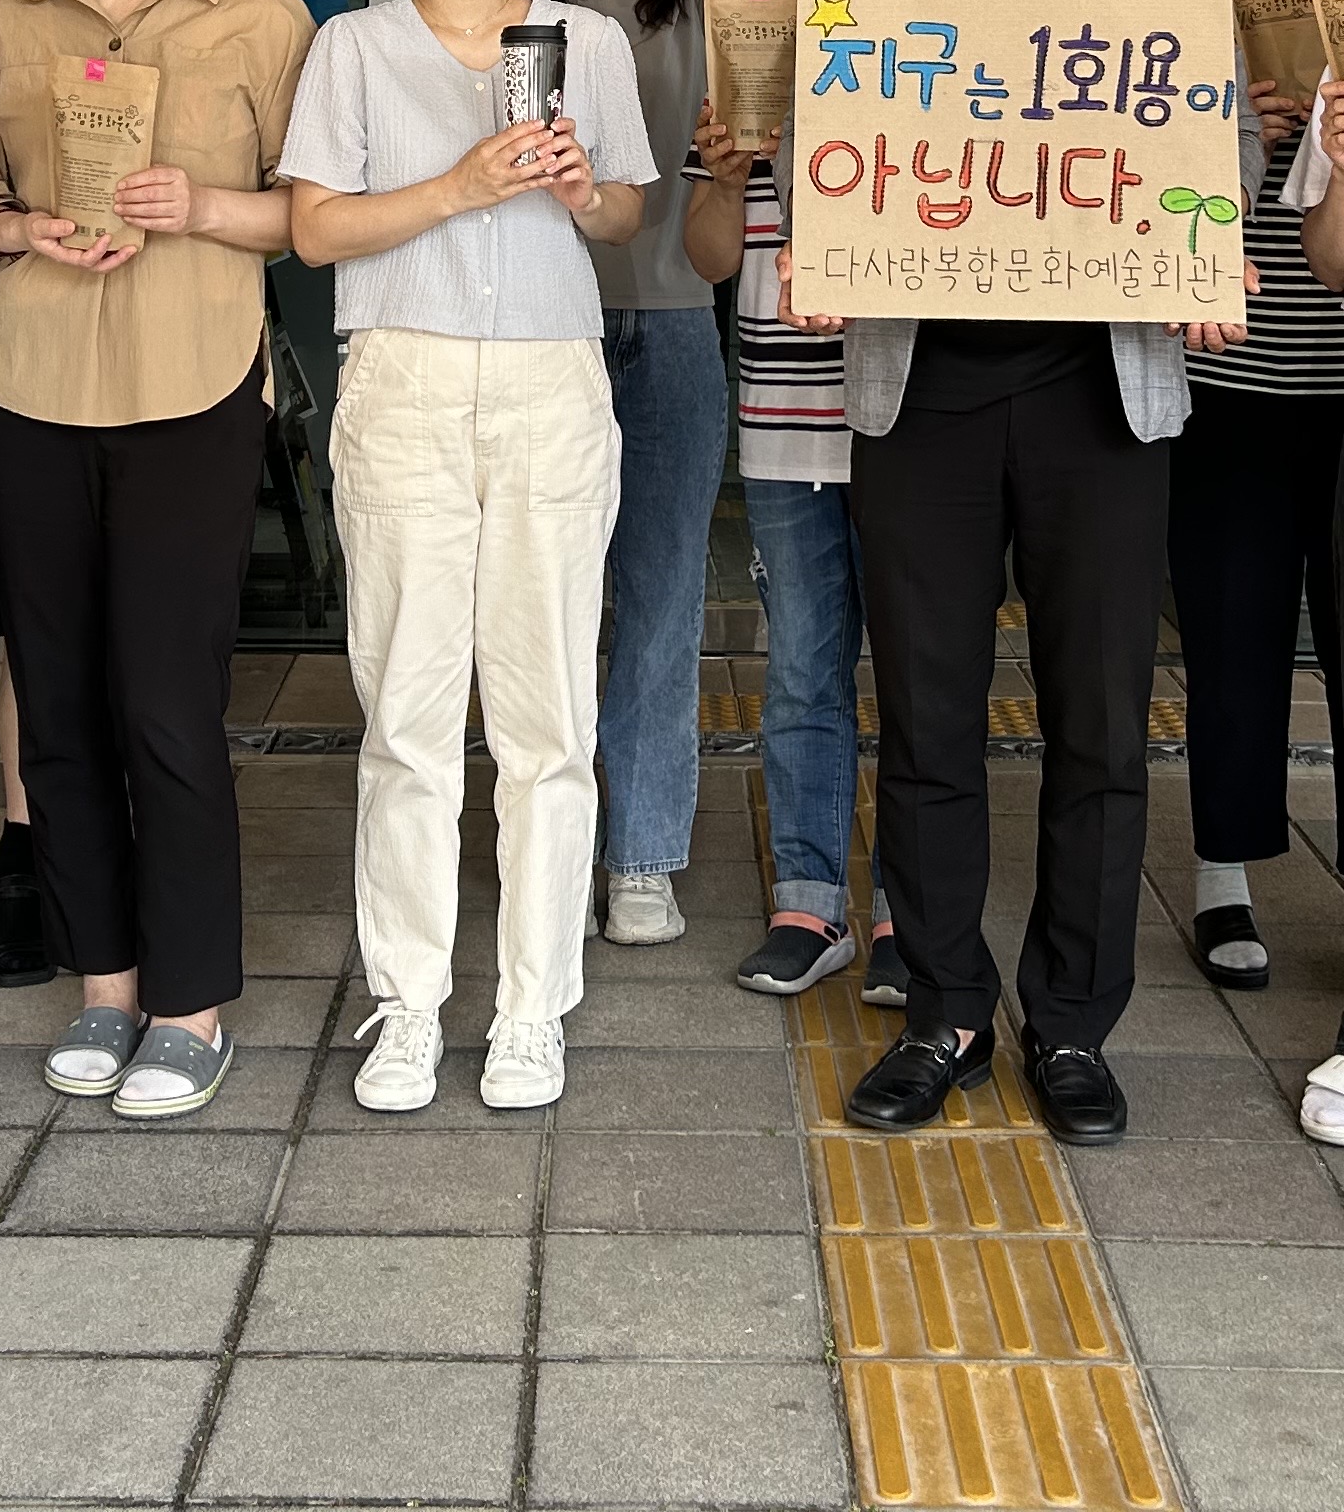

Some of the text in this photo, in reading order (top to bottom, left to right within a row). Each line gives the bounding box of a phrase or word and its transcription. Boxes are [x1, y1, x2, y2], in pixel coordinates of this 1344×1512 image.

[811, 21, 1009, 120] 지구는
[1020, 23, 1235, 127] 1회용이
[809, 133, 1151, 235] 아닙니다.
